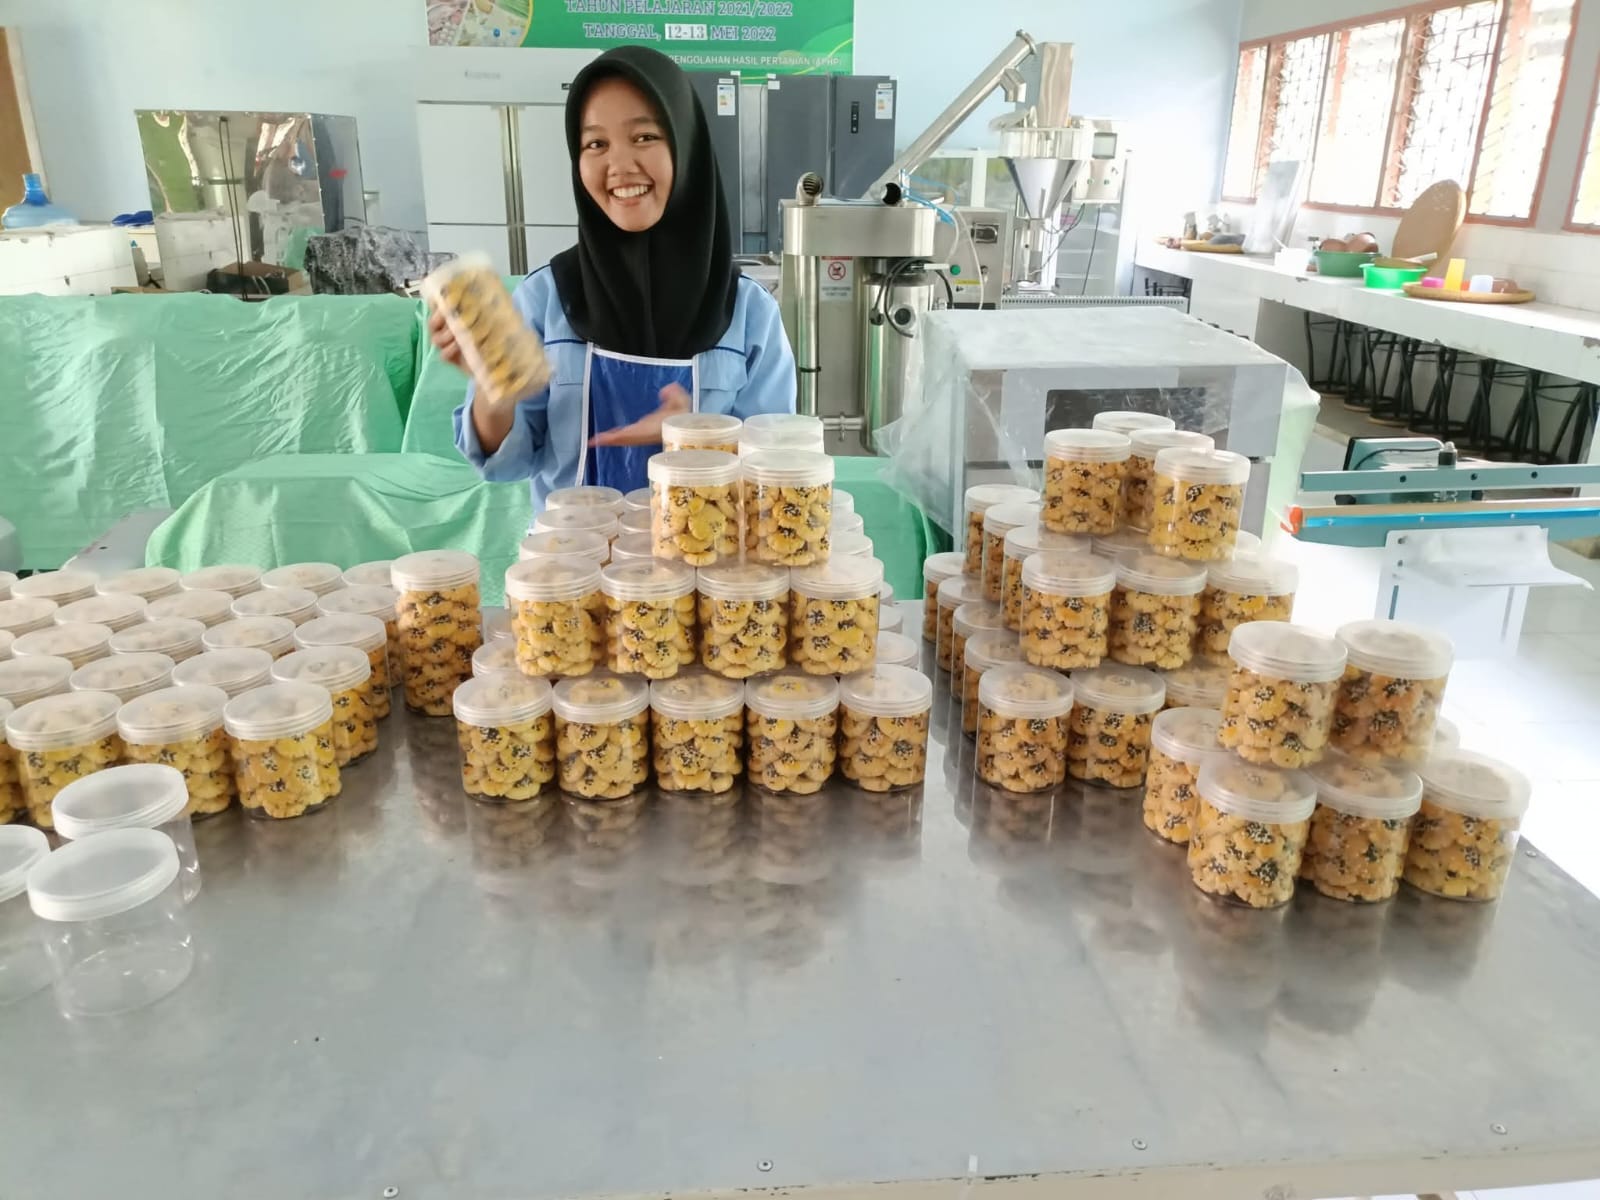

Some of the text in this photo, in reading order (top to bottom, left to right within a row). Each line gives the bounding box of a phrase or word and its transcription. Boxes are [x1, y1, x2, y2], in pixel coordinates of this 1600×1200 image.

[565, 0, 793, 17] TAHUN PELAJARAN 2021/2022
[583, 22, 776, 41] TANGGAL, 12-13 MEI 2022
[732, 56, 758, 65] HASIL
